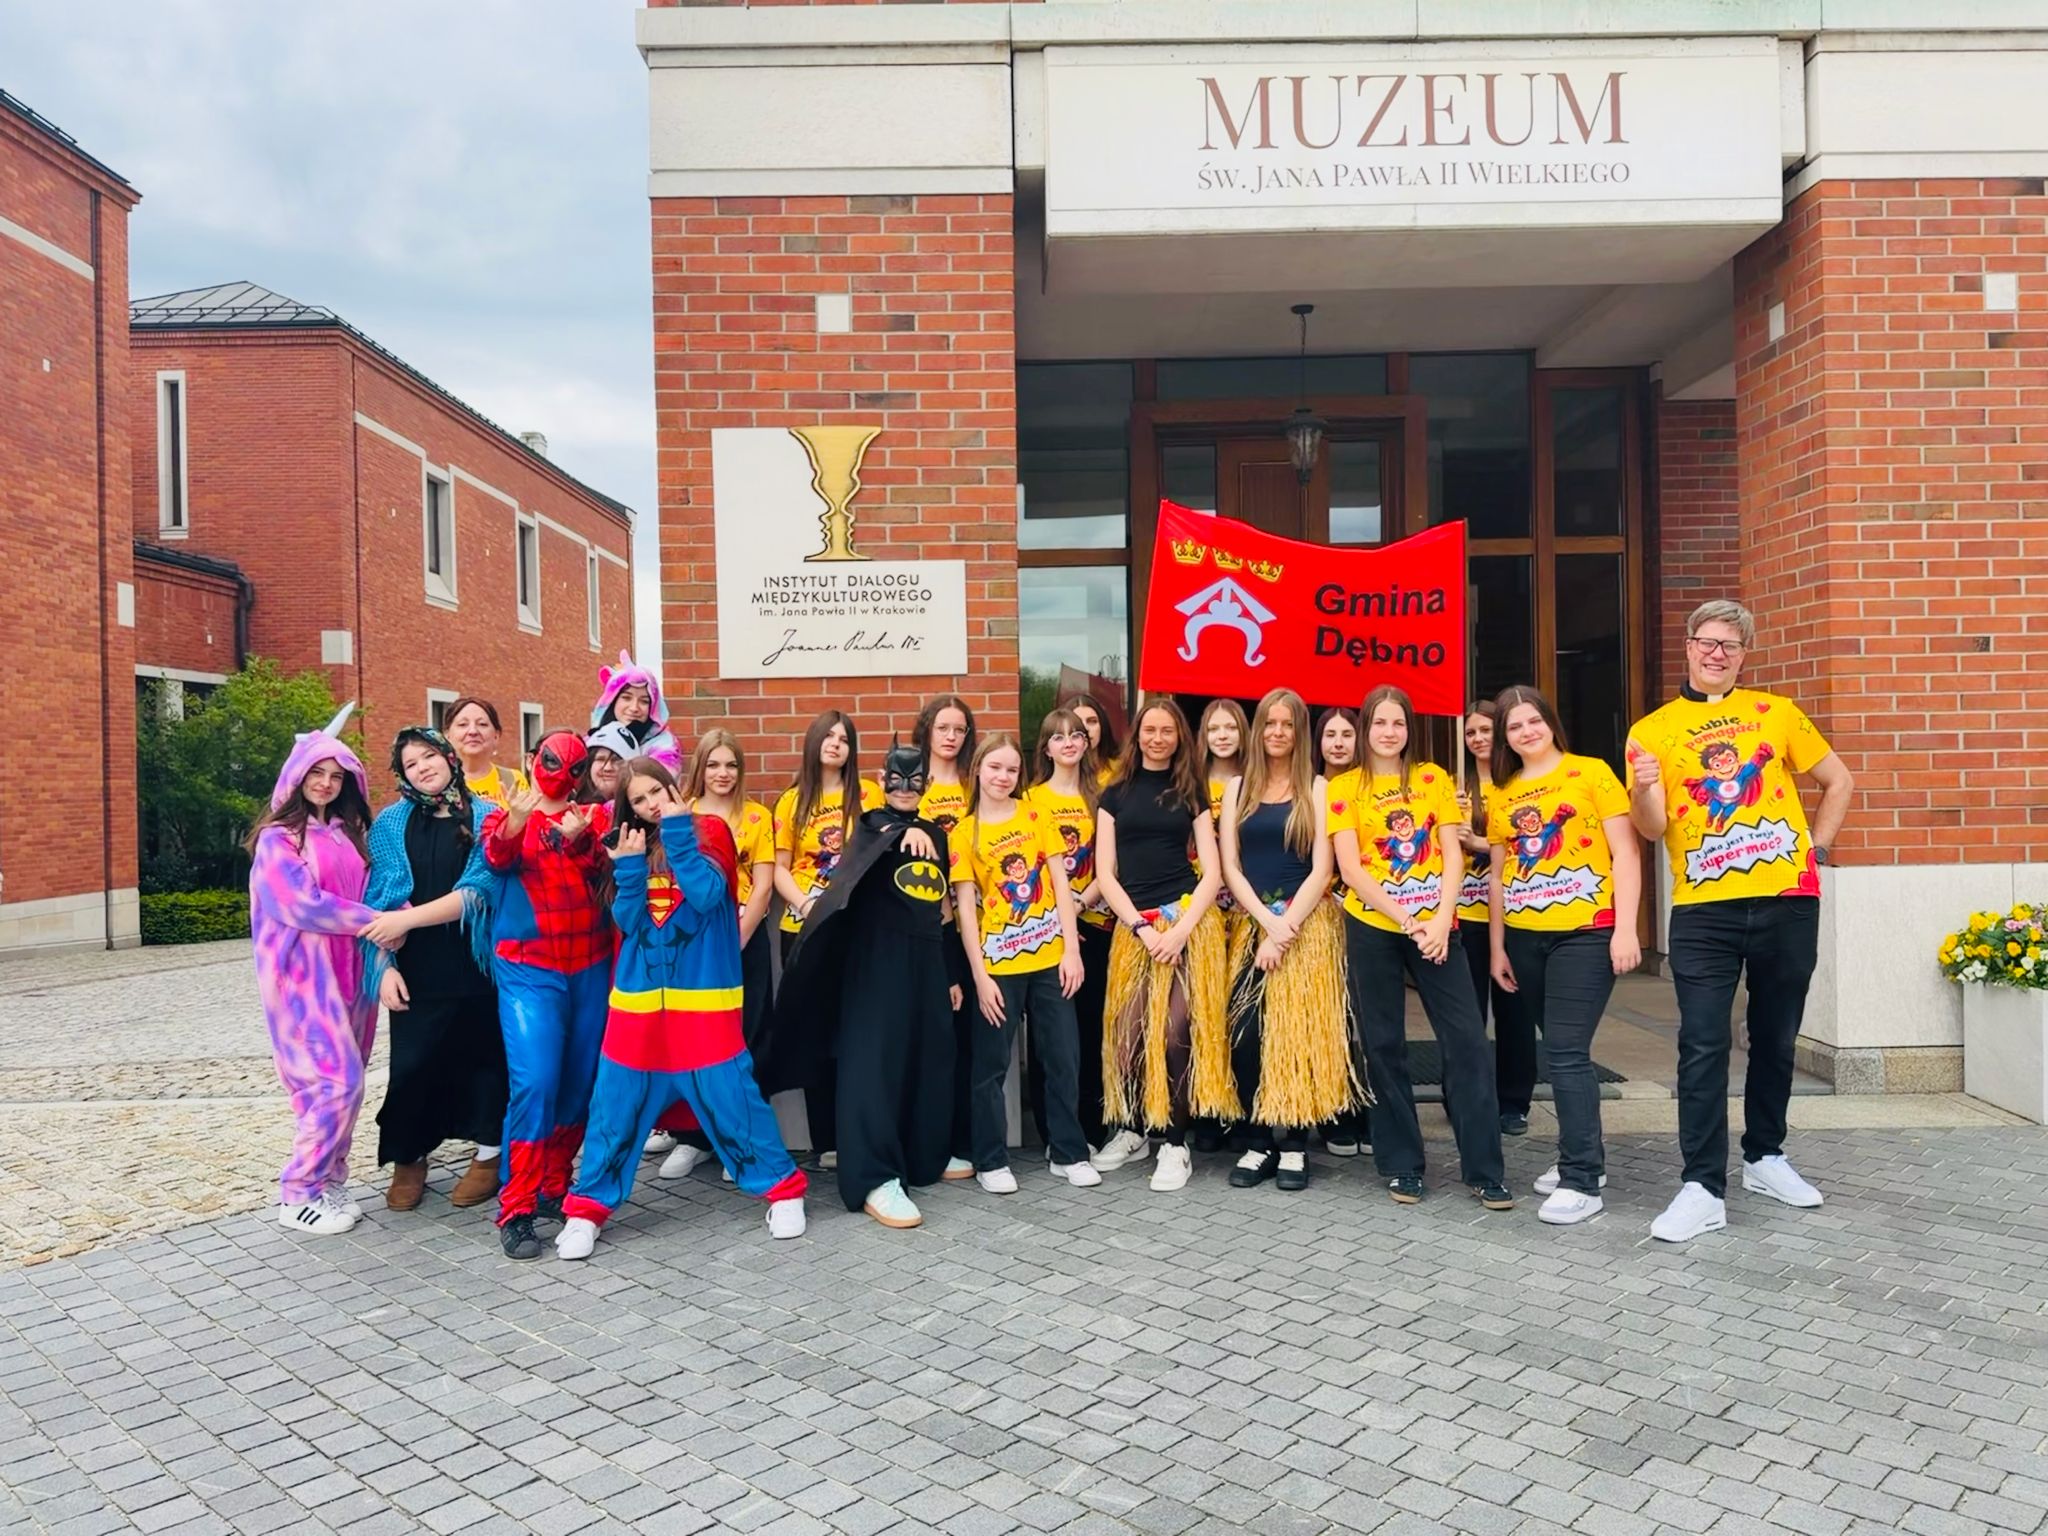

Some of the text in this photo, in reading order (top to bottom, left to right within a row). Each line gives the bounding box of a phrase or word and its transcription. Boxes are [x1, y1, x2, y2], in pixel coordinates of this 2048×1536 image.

[1196, 71, 1630, 150] MUZEUM
[1250, 165, 1324, 194] JANA
[1333, 163, 1431, 187] PAWŁA
[1440, 162, 1458, 185] II
[1467, 162, 1630, 184] WIELKIEGO
[764, 574, 919, 588] INSTYTUT DIALOGU
[751, 589, 932, 605] MIĘDZYKULTUROWEGO
[759, 607, 777, 616] im.
[781, 607, 808, 616] Jana
[812, 606, 845, 616] Pawła
[849, 606, 858, 615] II
[873, 605, 926, 615] Krakowie
[1314, 583, 1445, 617] Gmina
[1314, 625, 1445, 668] Dębno
[1683, 721, 1761, 752] pomagać!
[1686, 715, 1741, 736] Lubię
[1699, 836, 1783, 871] supermoc?
[1725, 836, 1744, 850] jest
